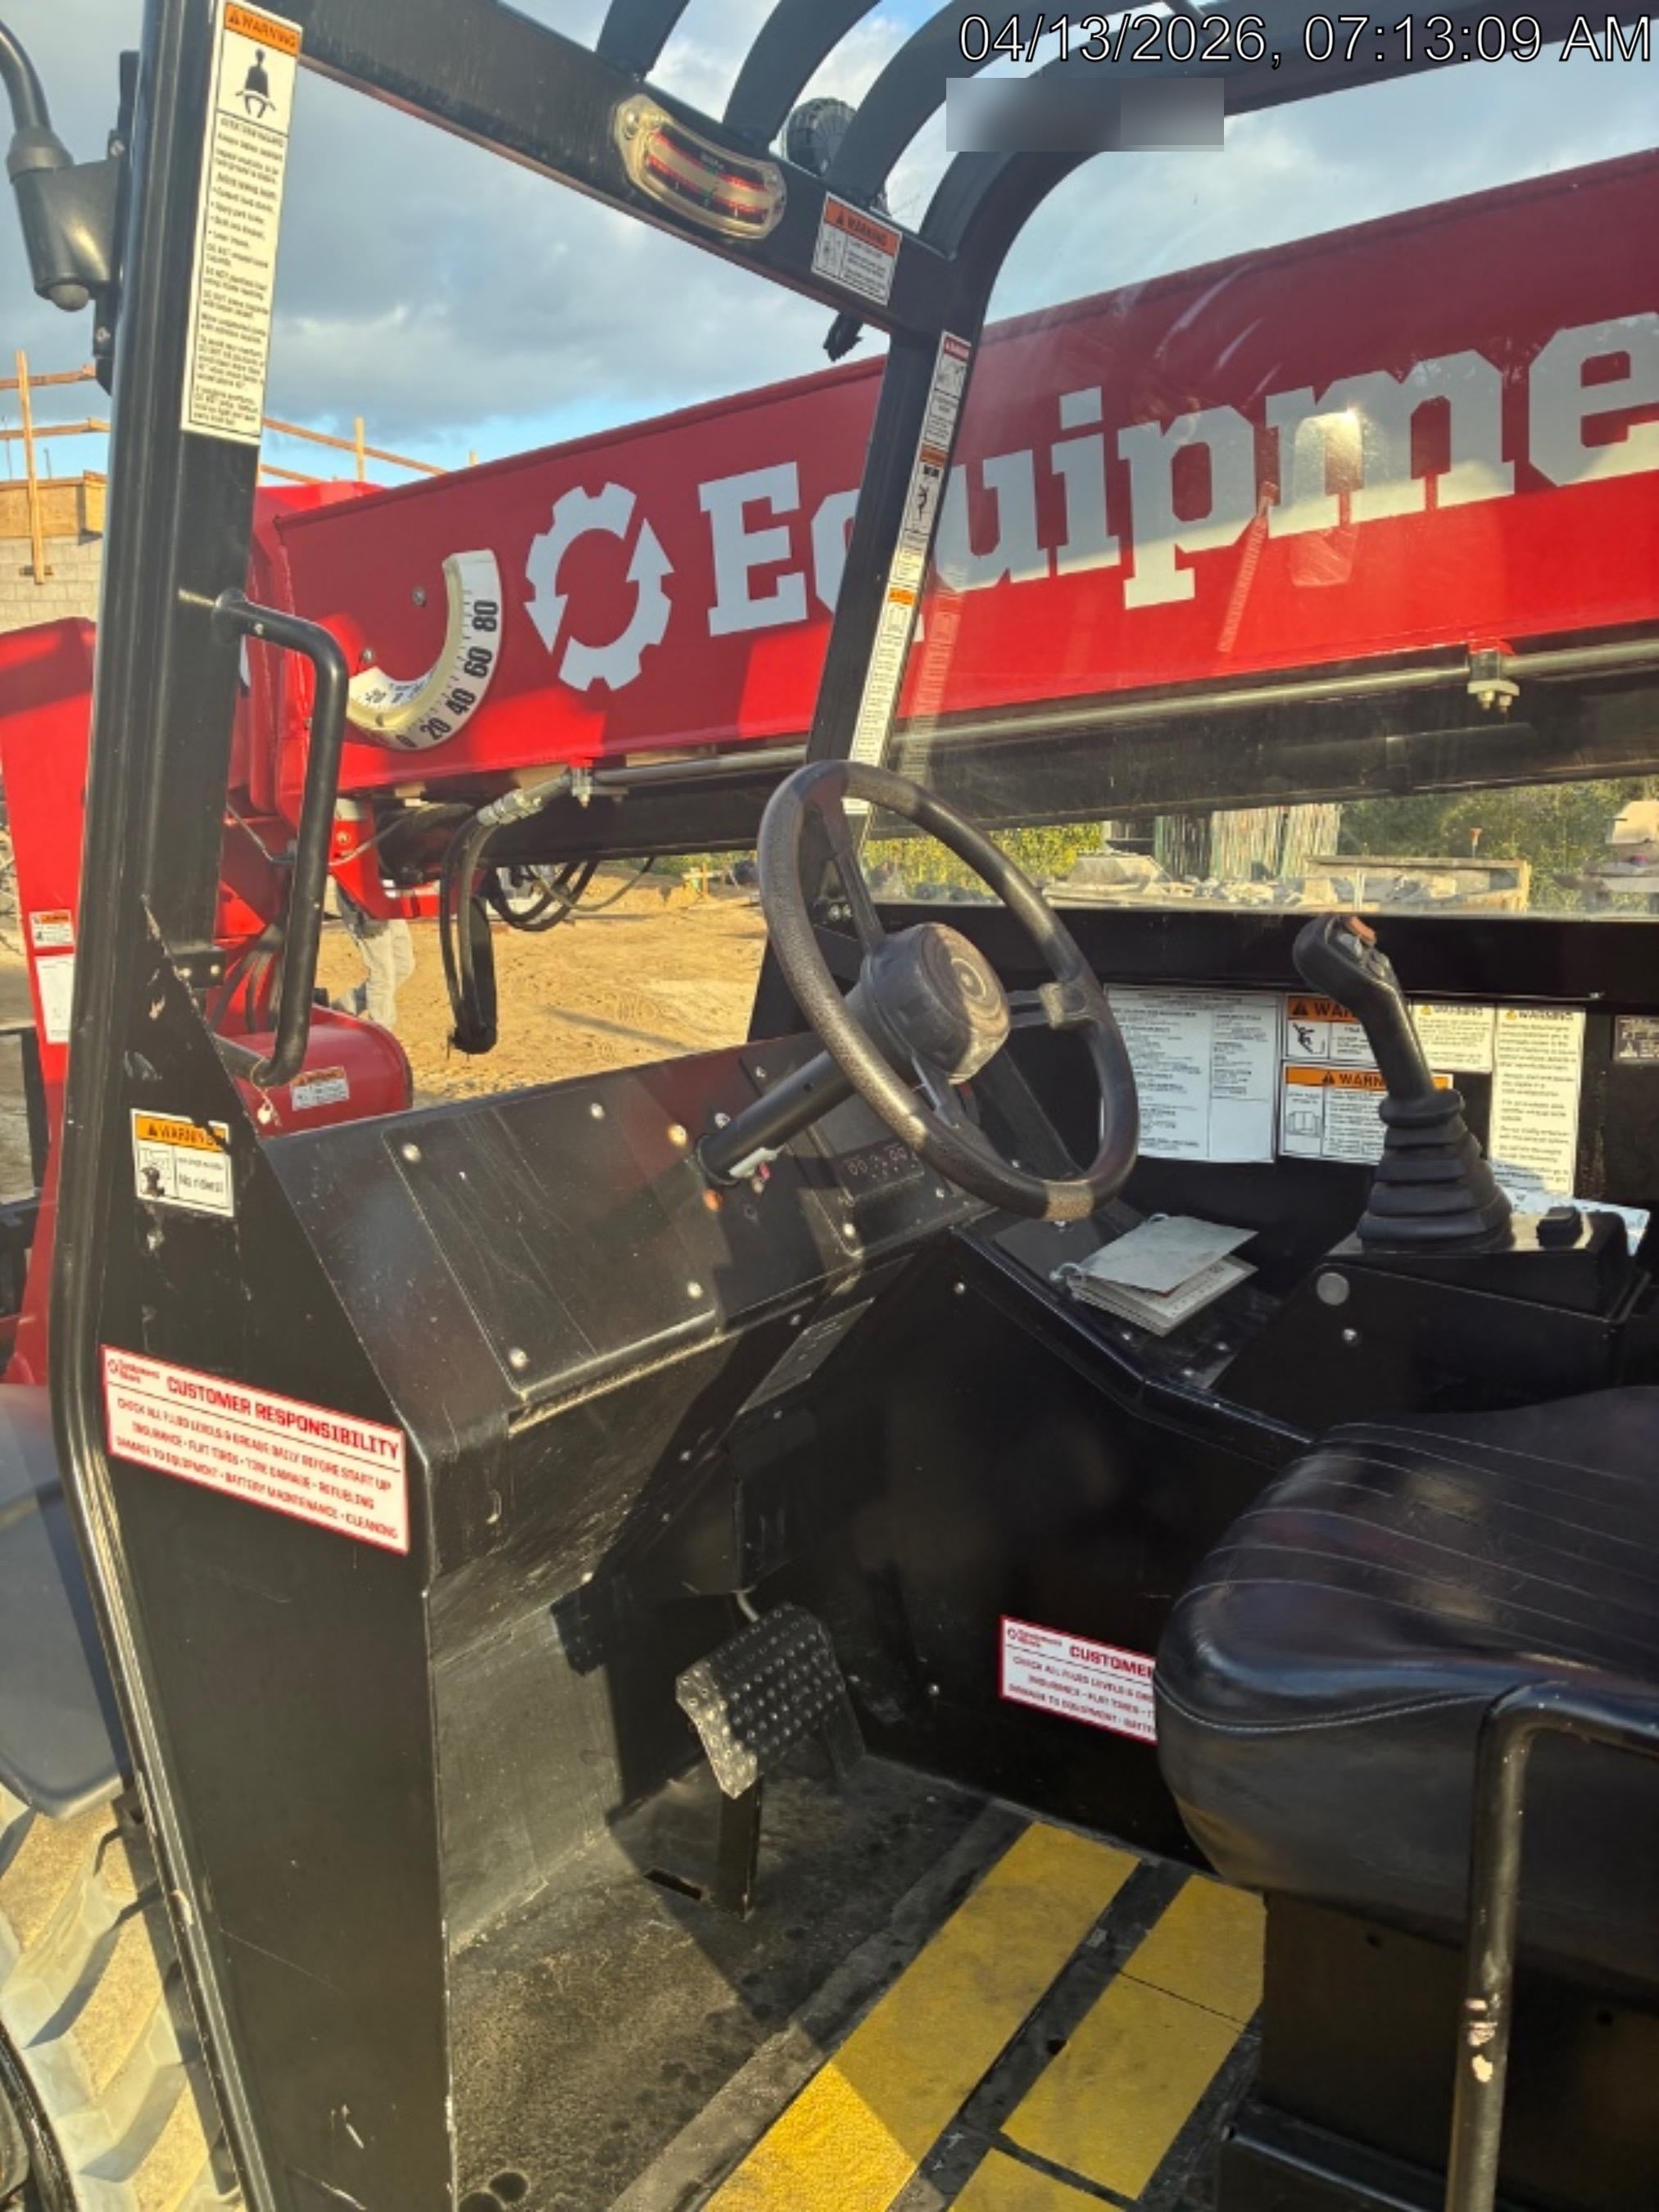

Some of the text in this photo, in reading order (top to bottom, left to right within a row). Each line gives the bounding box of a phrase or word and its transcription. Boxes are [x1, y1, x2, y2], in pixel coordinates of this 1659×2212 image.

[472, 600, 498, 632] 80
[463, 646, 492, 678] 60
[445, 688, 476, 715] 40
[419, 717, 451, 740] 20
[166, 1376, 398, 1461] CUSTOMER RESPONSIBILITY
[301, 1454, 338, 1475] BEFORE
